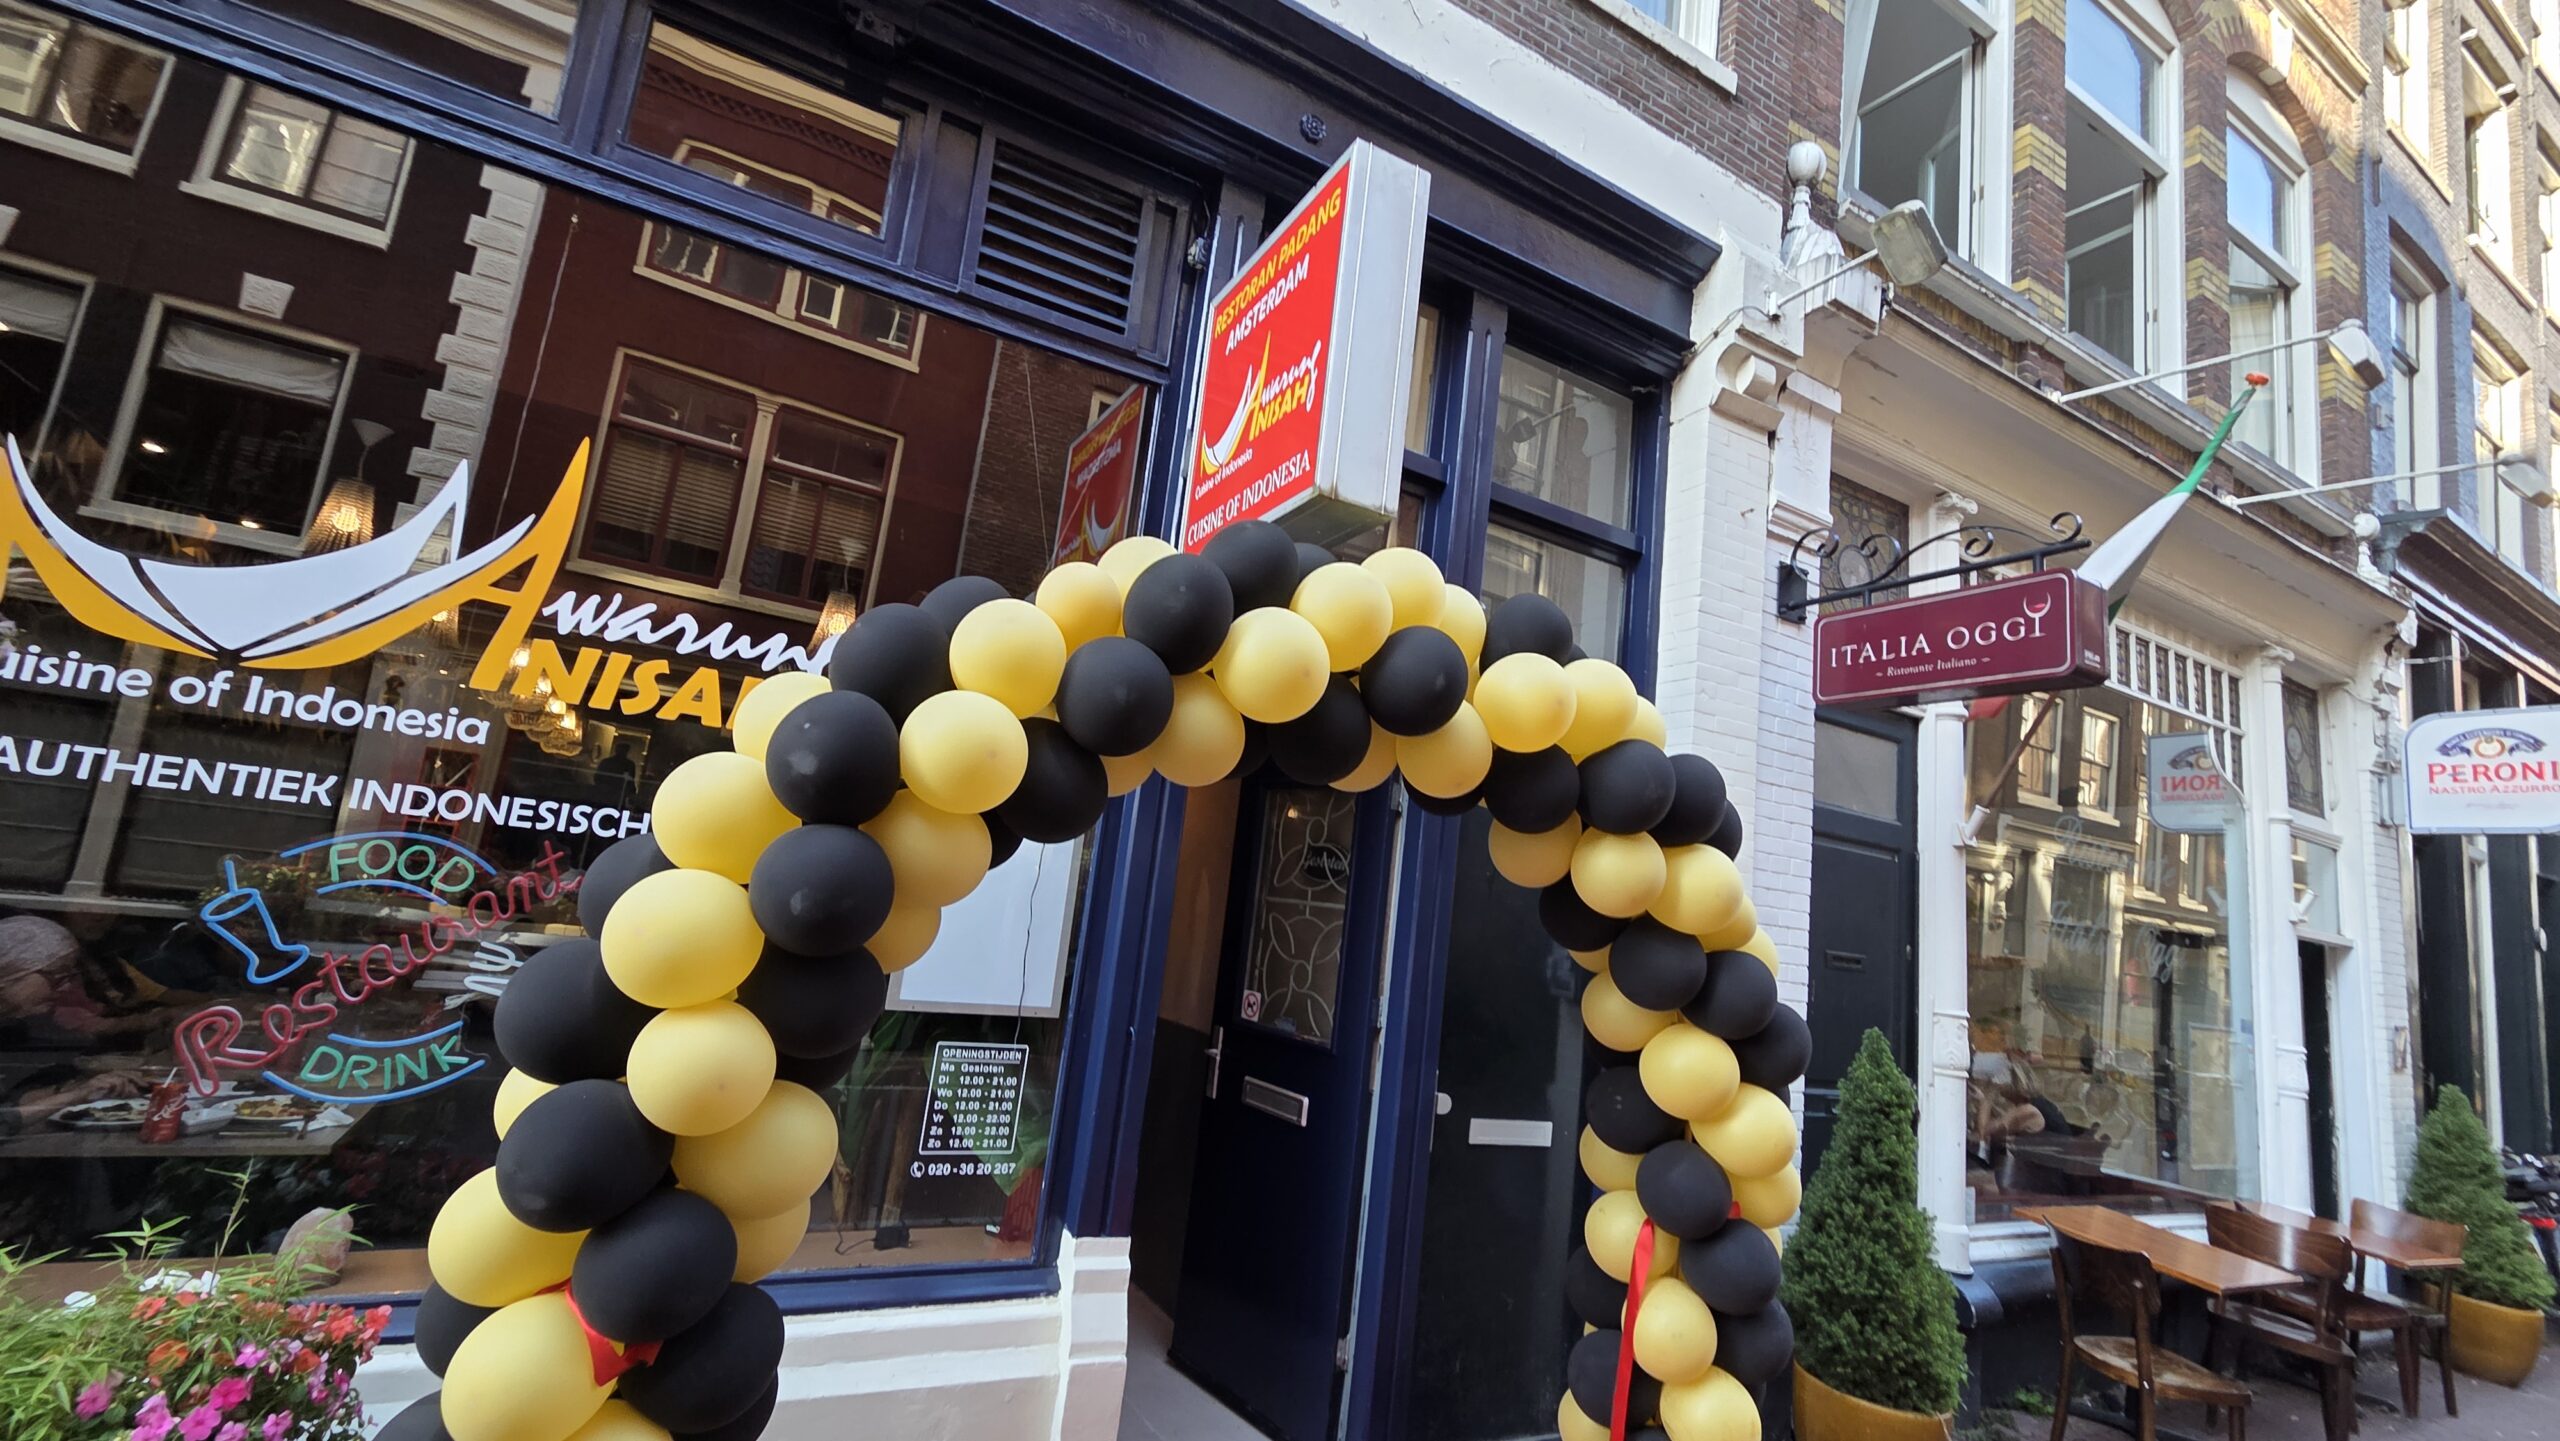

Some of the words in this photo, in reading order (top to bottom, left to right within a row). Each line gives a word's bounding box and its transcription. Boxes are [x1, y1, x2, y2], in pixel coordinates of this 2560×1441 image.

[1215, 255, 1277, 339] RESTORAN
[1278, 187, 1341, 270] PADANG
[1226, 253, 1310, 356] AMSTERDAM
[1188, 503, 1225, 546] CUISINE
[1226, 493, 1241, 521] OF
[1242, 449, 1311, 511] INDONESIA
[1831, 633, 1931, 668] ITALIA
[1887, 664, 1934, 677] Ristorante
[1937, 658, 1977, 670] Italiano
[0, 645, 152, 697] uisine
[169, 670, 234, 708] of
[243, 675, 490, 745] Indonesia
[0, 735, 338, 807] AUTHENTIEK
[2427, 760, 2560, 784] PERONI
[2429, 786, 2486, 795] NASTRO
[2490, 784, 2560, 794] AZZURRO
[329, 840, 475, 893] FOOD
[173, 840, 584, 1097] Restaurant
[300, 1035, 470, 1090] DRINK
[942, 1048, 1021, 1060] OPENINGSTIJDEN
[940, 1063, 955, 1072] Ma
[961, 1063, 1004, 1073] Gesloten
[960, 1076, 984, 1085] 12.00
[992, 1077, 1017, 1086] 21.00
[937, 1088, 952, 1097] Wo
[957, 1088, 981, 1098] 12.00
[990, 1089, 1015, 1098] 21.00
[934, 1101, 948, 1110] Do
[955, 1101, 979, 1110] 12.00
[988, 1101, 1013, 1111] 21.00
[932, 1113, 944, 1123] Vr
[953, 1114, 977, 1123] 12.00
[986, 1114, 1011, 1123] 22.00
[929, 1126, 942, 1135] Za
[951, 1126, 975, 1136] 12.00
[984, 1126, 1009, 1136] 22.00
[927, 1139, 941, 1148] Zo
[949, 1139, 973, 1148] 12.00
[982, 1139, 1007, 1148] 21.00
[928, 1163, 951, 1175] 020
[959, 1163, 974, 1175] 36
[976, 1163, 991, 1175] 20
[994, 1163, 1016, 1175] 267
